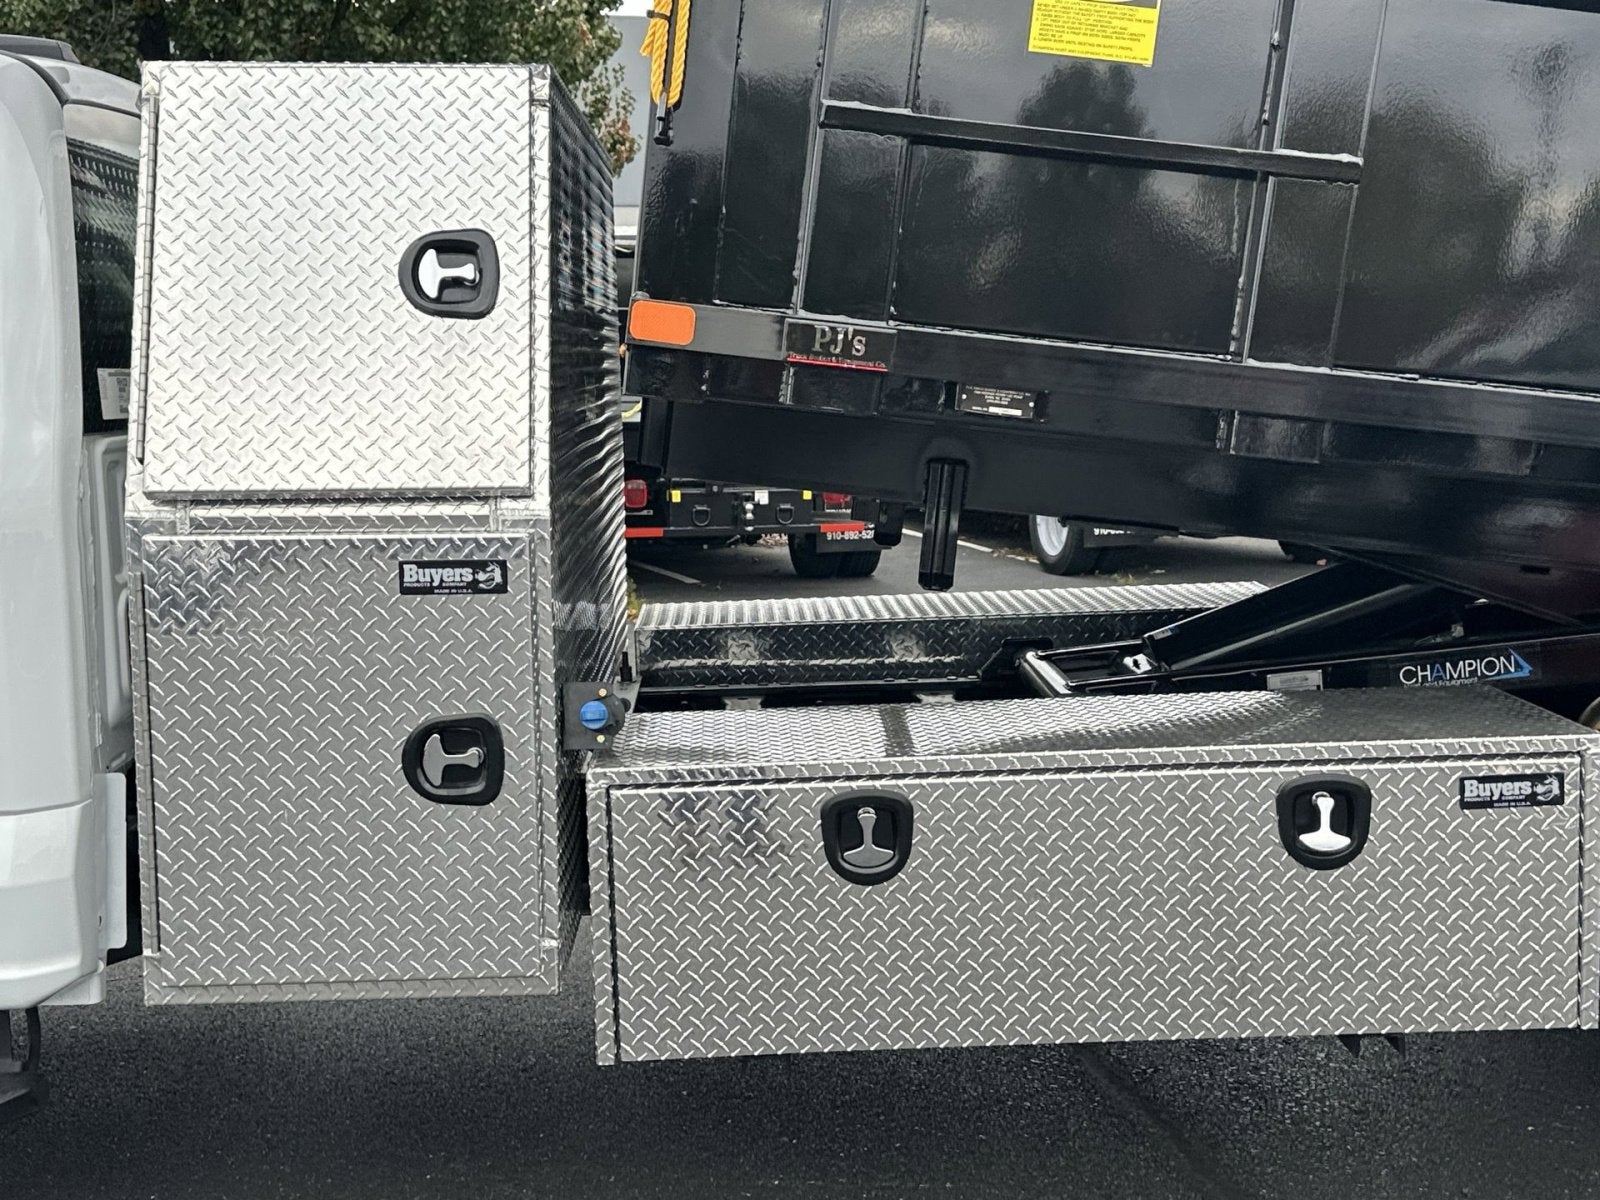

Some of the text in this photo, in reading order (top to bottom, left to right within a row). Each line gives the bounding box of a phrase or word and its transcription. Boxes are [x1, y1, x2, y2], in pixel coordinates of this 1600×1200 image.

[811, 324, 866, 356] PJ's
[403, 564, 473, 586] Buyers
[1400, 655, 1515, 684] CHAMPION
[1464, 779, 1532, 800] Buyers
